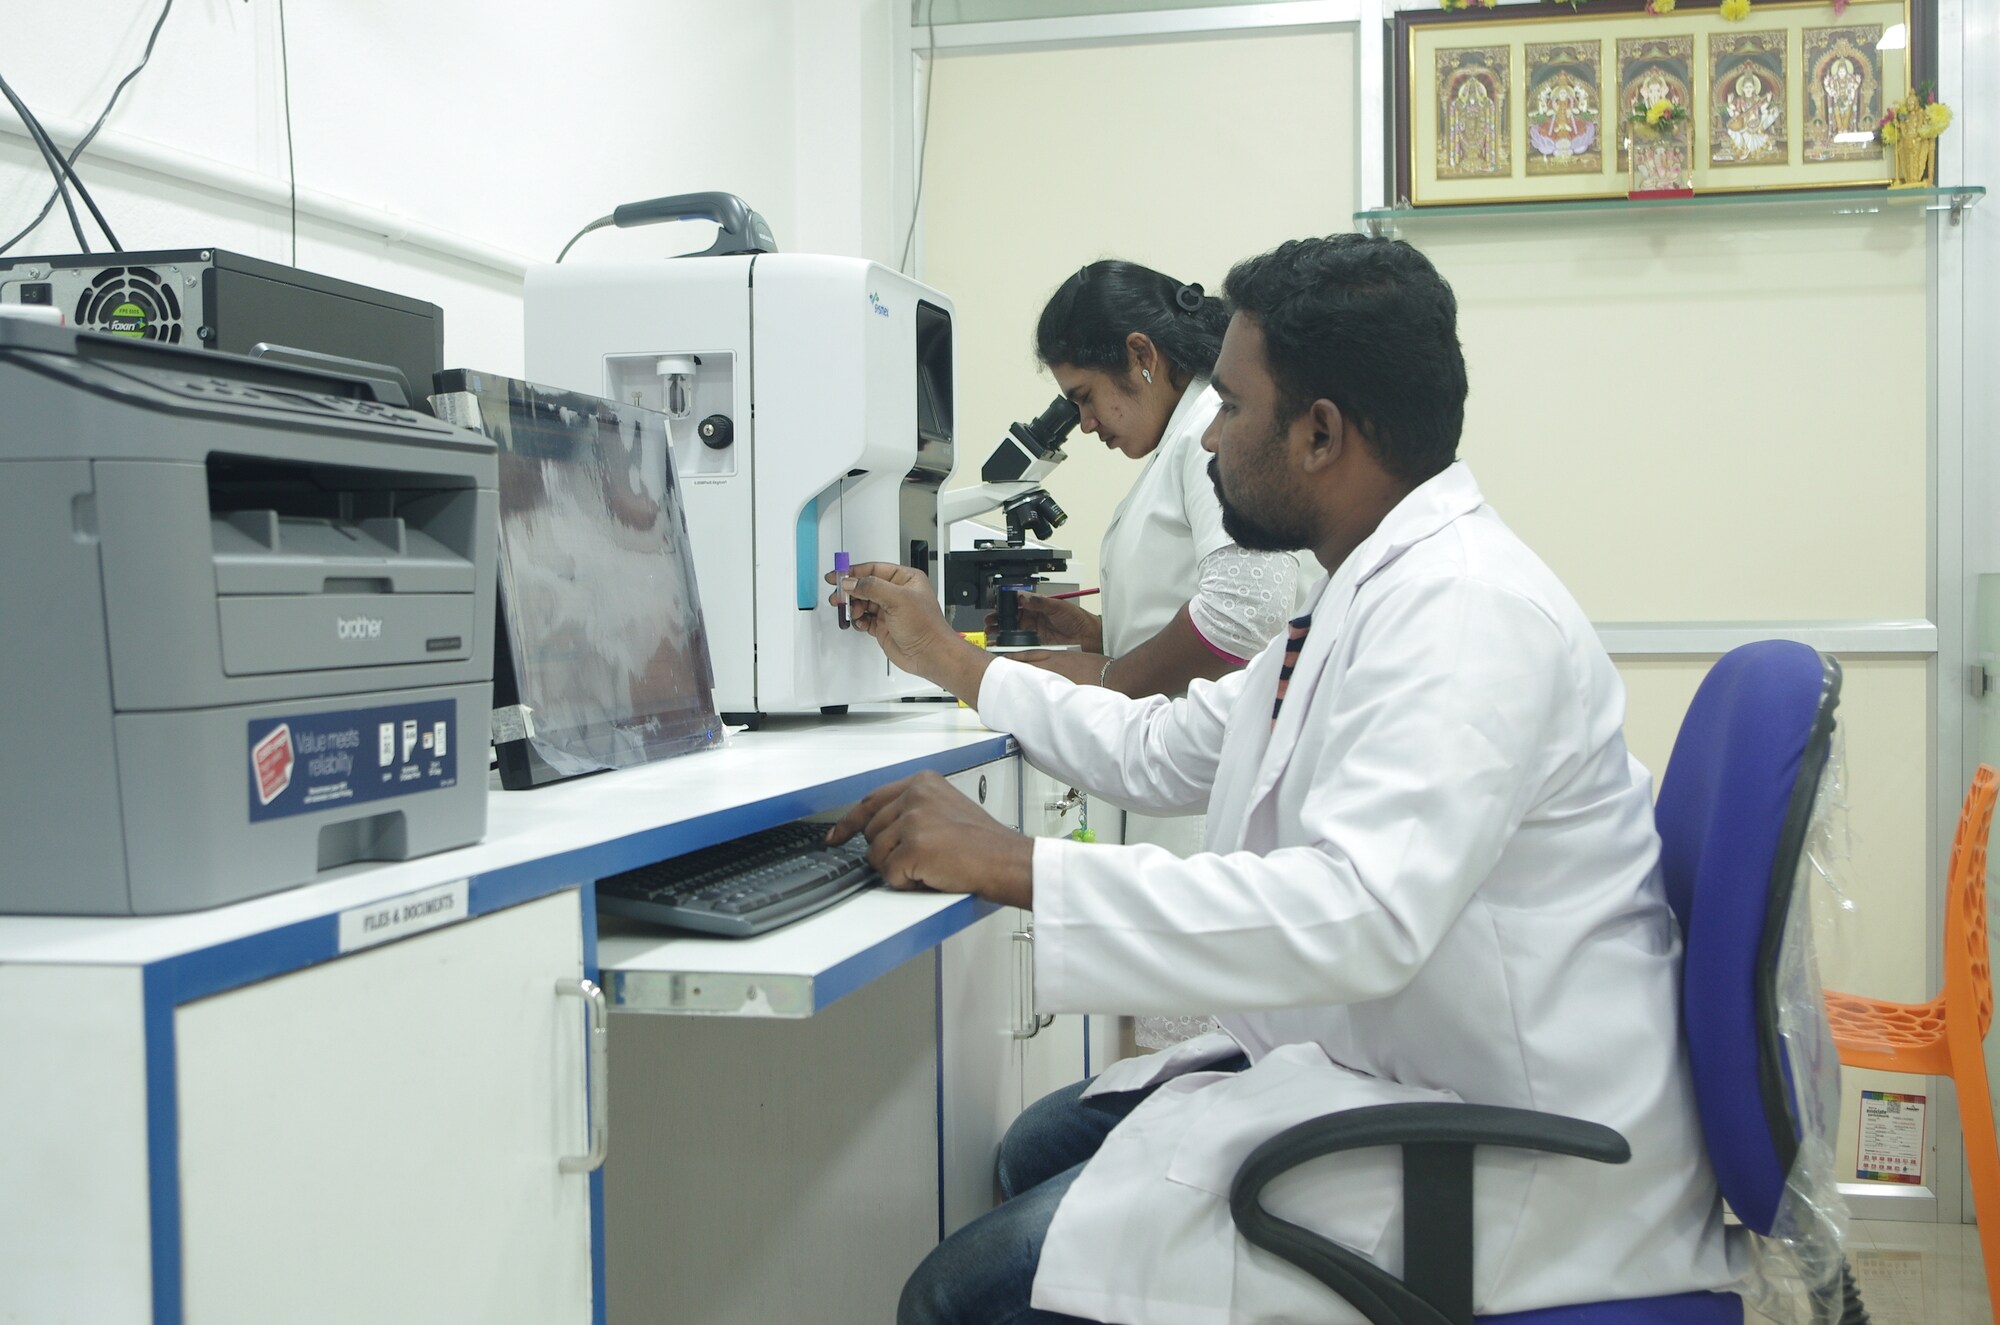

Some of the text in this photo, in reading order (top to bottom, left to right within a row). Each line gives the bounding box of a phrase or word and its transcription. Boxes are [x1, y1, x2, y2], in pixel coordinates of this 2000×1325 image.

[337, 616, 383, 639] brother
[296, 729, 359, 754] Value meets
[308, 751, 354, 776] reliability
[363, 909, 391, 933] FILES
[402, 893, 454, 921] DOCUMENTS
